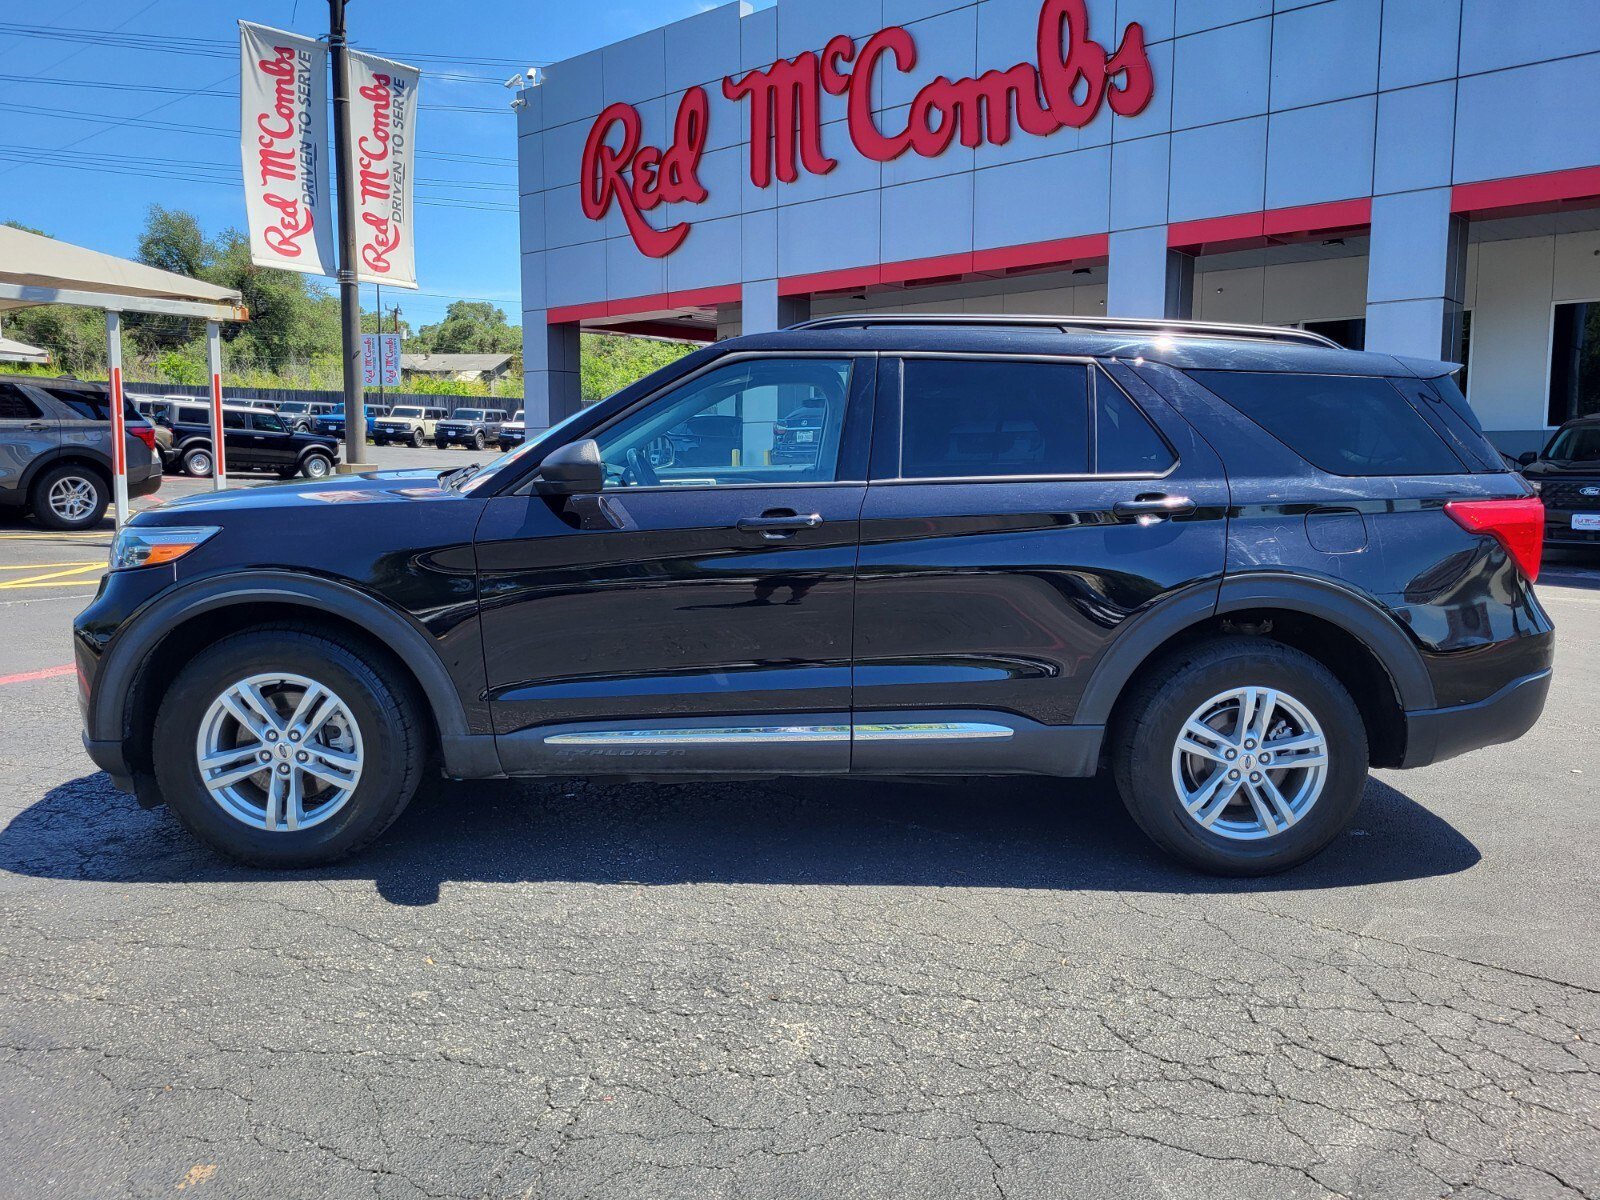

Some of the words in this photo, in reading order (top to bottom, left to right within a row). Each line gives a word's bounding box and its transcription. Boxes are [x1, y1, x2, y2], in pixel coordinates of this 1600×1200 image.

[298, 50, 312, 107] SERVE
[393, 76, 405, 129] SERVE
[258, 46, 296, 187] McCombs
[298, 111, 312, 136] TO
[358, 72, 391, 206] McCombs
[392, 134, 405, 155] TO
[580, 85, 709, 258] Red
[721, 0, 1155, 189] McCombs
[299, 140, 315, 208] DRIVEN
[391, 161, 404, 224] DRIVEN
[263, 192, 315, 257] Red
[362, 211, 401, 274] Red
